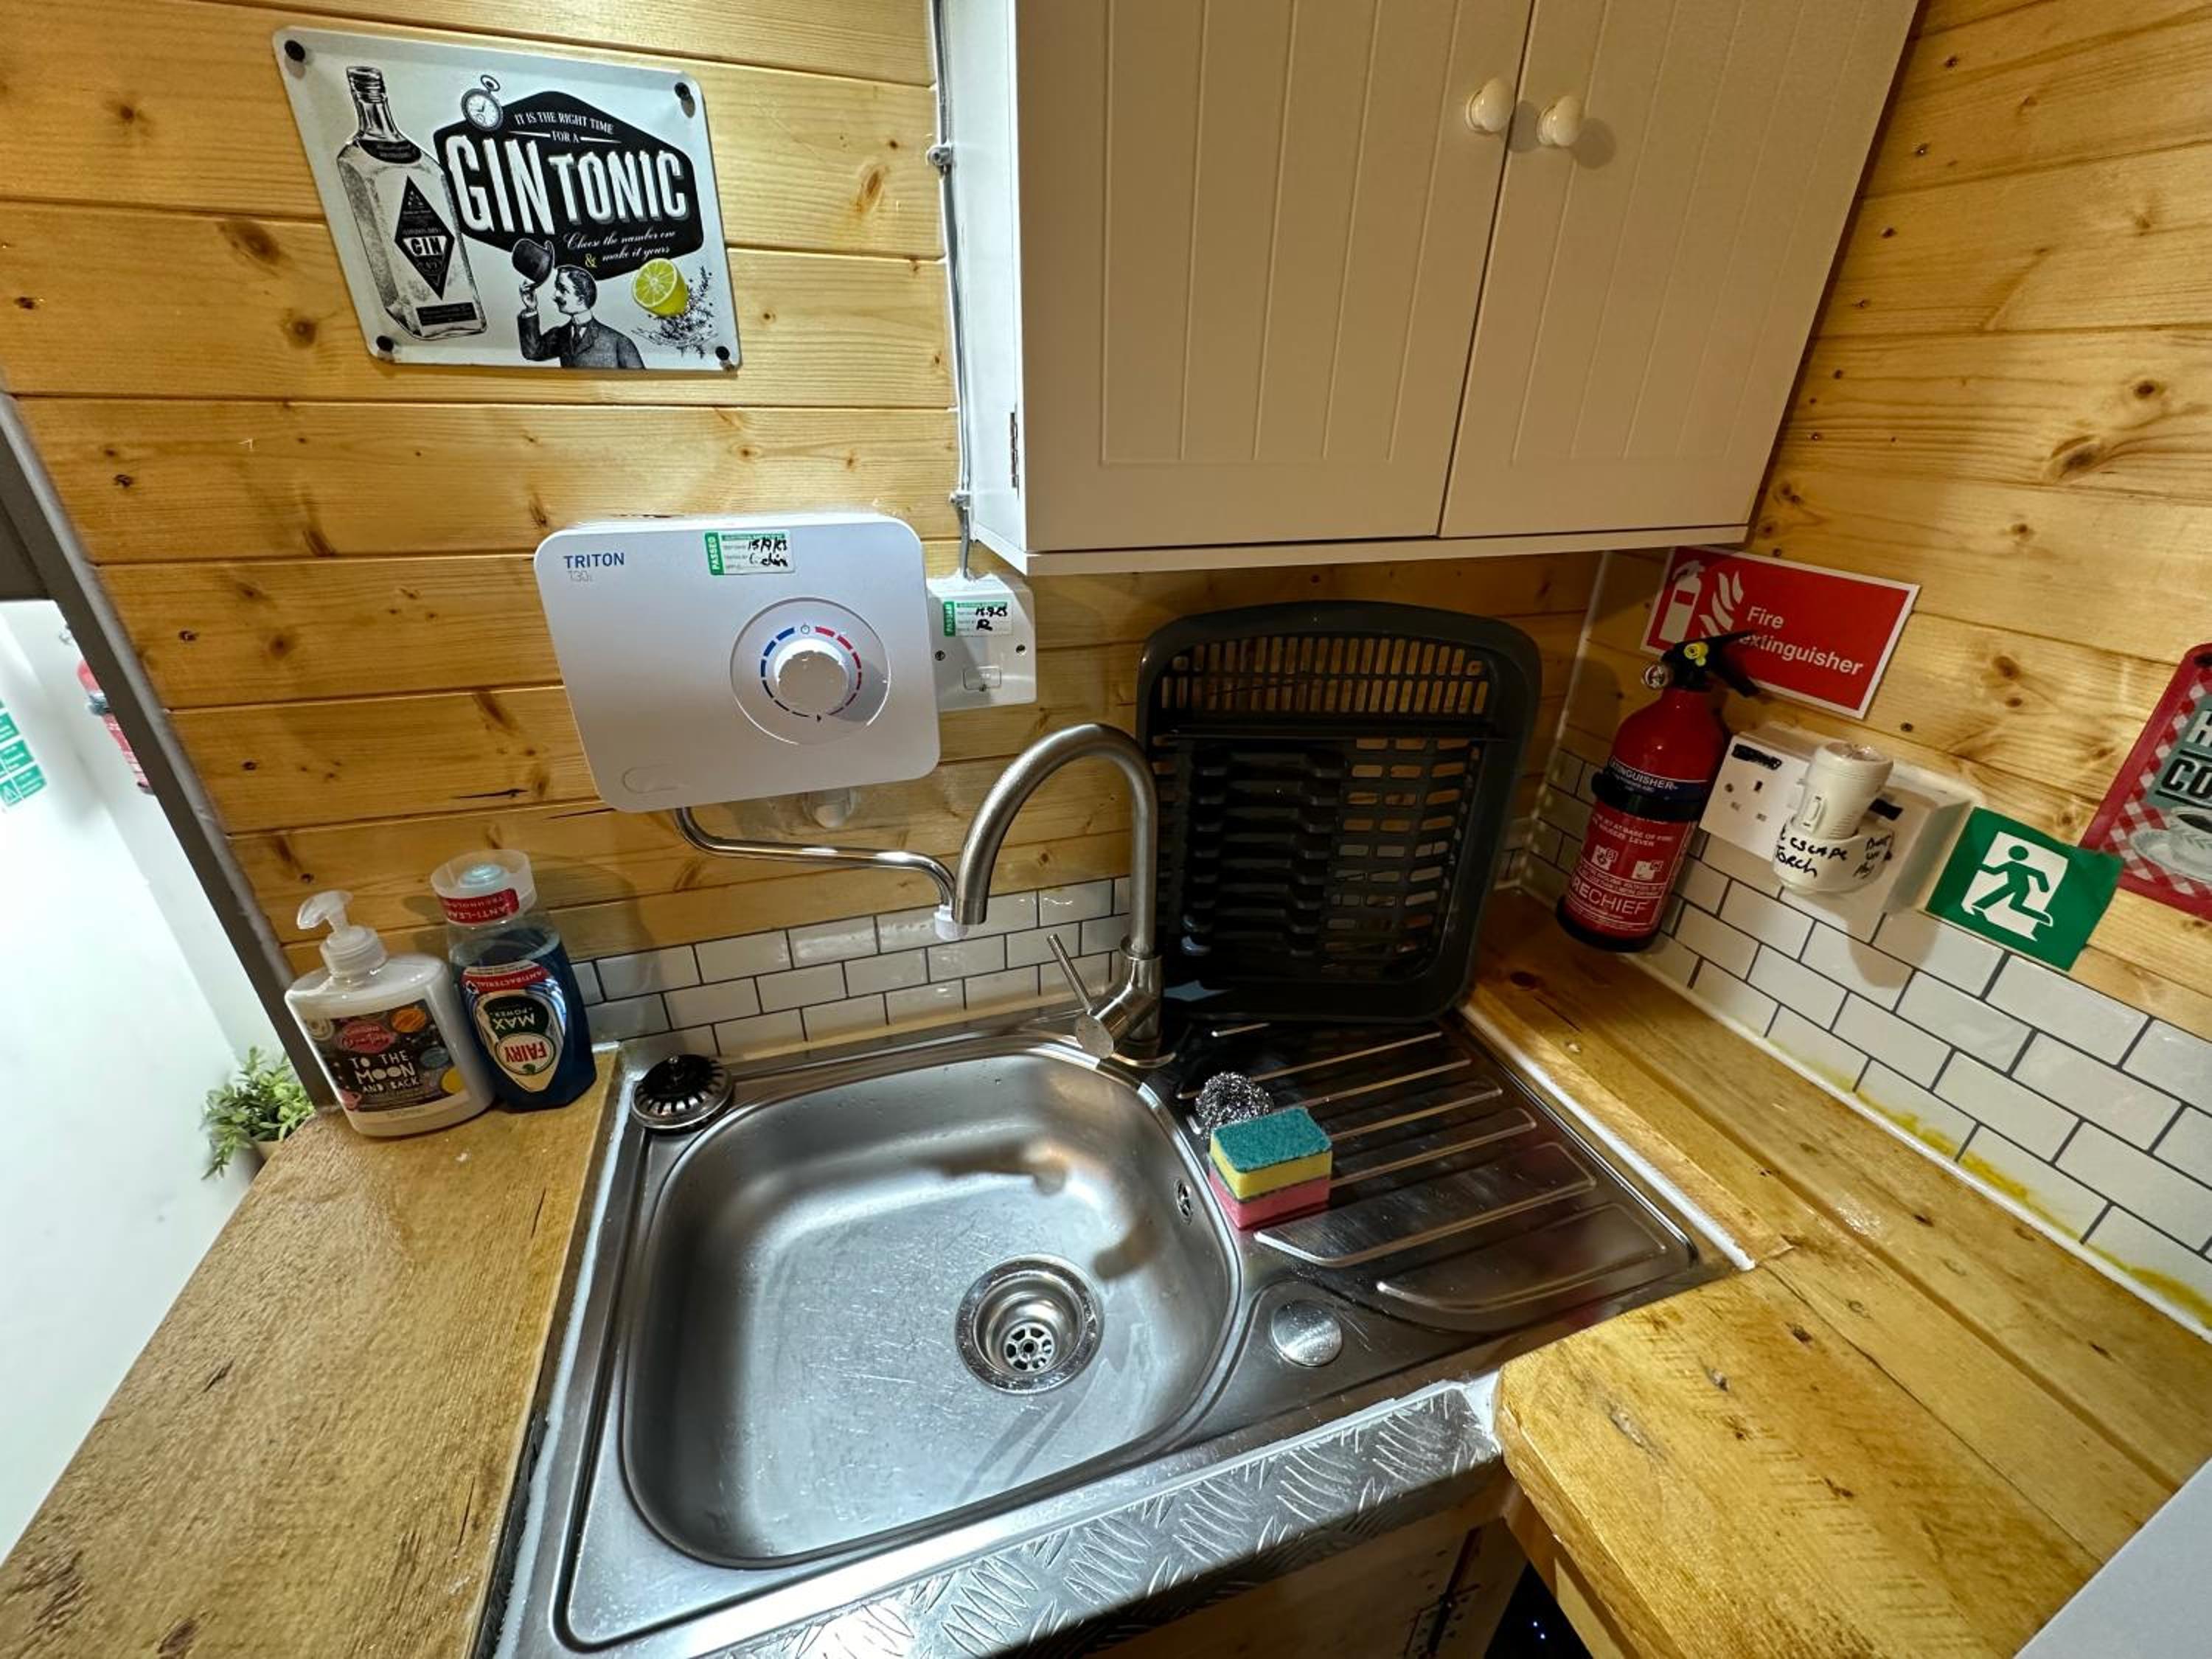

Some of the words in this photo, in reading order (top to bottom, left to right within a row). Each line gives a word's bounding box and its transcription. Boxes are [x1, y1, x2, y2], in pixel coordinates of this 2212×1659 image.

[514, 113, 525, 125] IT
[526, 111, 537, 123] IS
[537, 111, 557, 123] THE
[558, 111, 587, 127] RIGHT
[590, 118, 614, 134] TIME
[552, 131, 571, 142] FOR
[573, 132, 580, 143] A
[445, 135, 554, 234] GIN
[548, 150, 689, 223] TONIC
[410, 237, 442, 256] GIN
[563, 231, 599, 250] Choose
[602, 230, 618, 246] the
[621, 226, 658, 244] number
[585, 253, 597, 269] &
[602, 244, 629, 262] make
[632, 246, 642, 257] it
[643, 246, 670, 261] yours
[563, 552, 625, 569] TRITON
[707, 535, 720, 570] PASSED
[1747, 606, 1784, 629] Fire
[476, 971, 542, 988] ANTIBACTERIAL
[492, 1013, 535, 1030] MAX
[495, 1008, 528, 1017] POWER
[348, 1057, 370, 1069] TO
[378, 1049, 409, 1065] THE
[505, 1041, 547, 1062] FAIRY
[354, 1062, 417, 1085] MOON
[362, 1082, 385, 1093] AND
[390, 1077, 420, 1090] BACK
